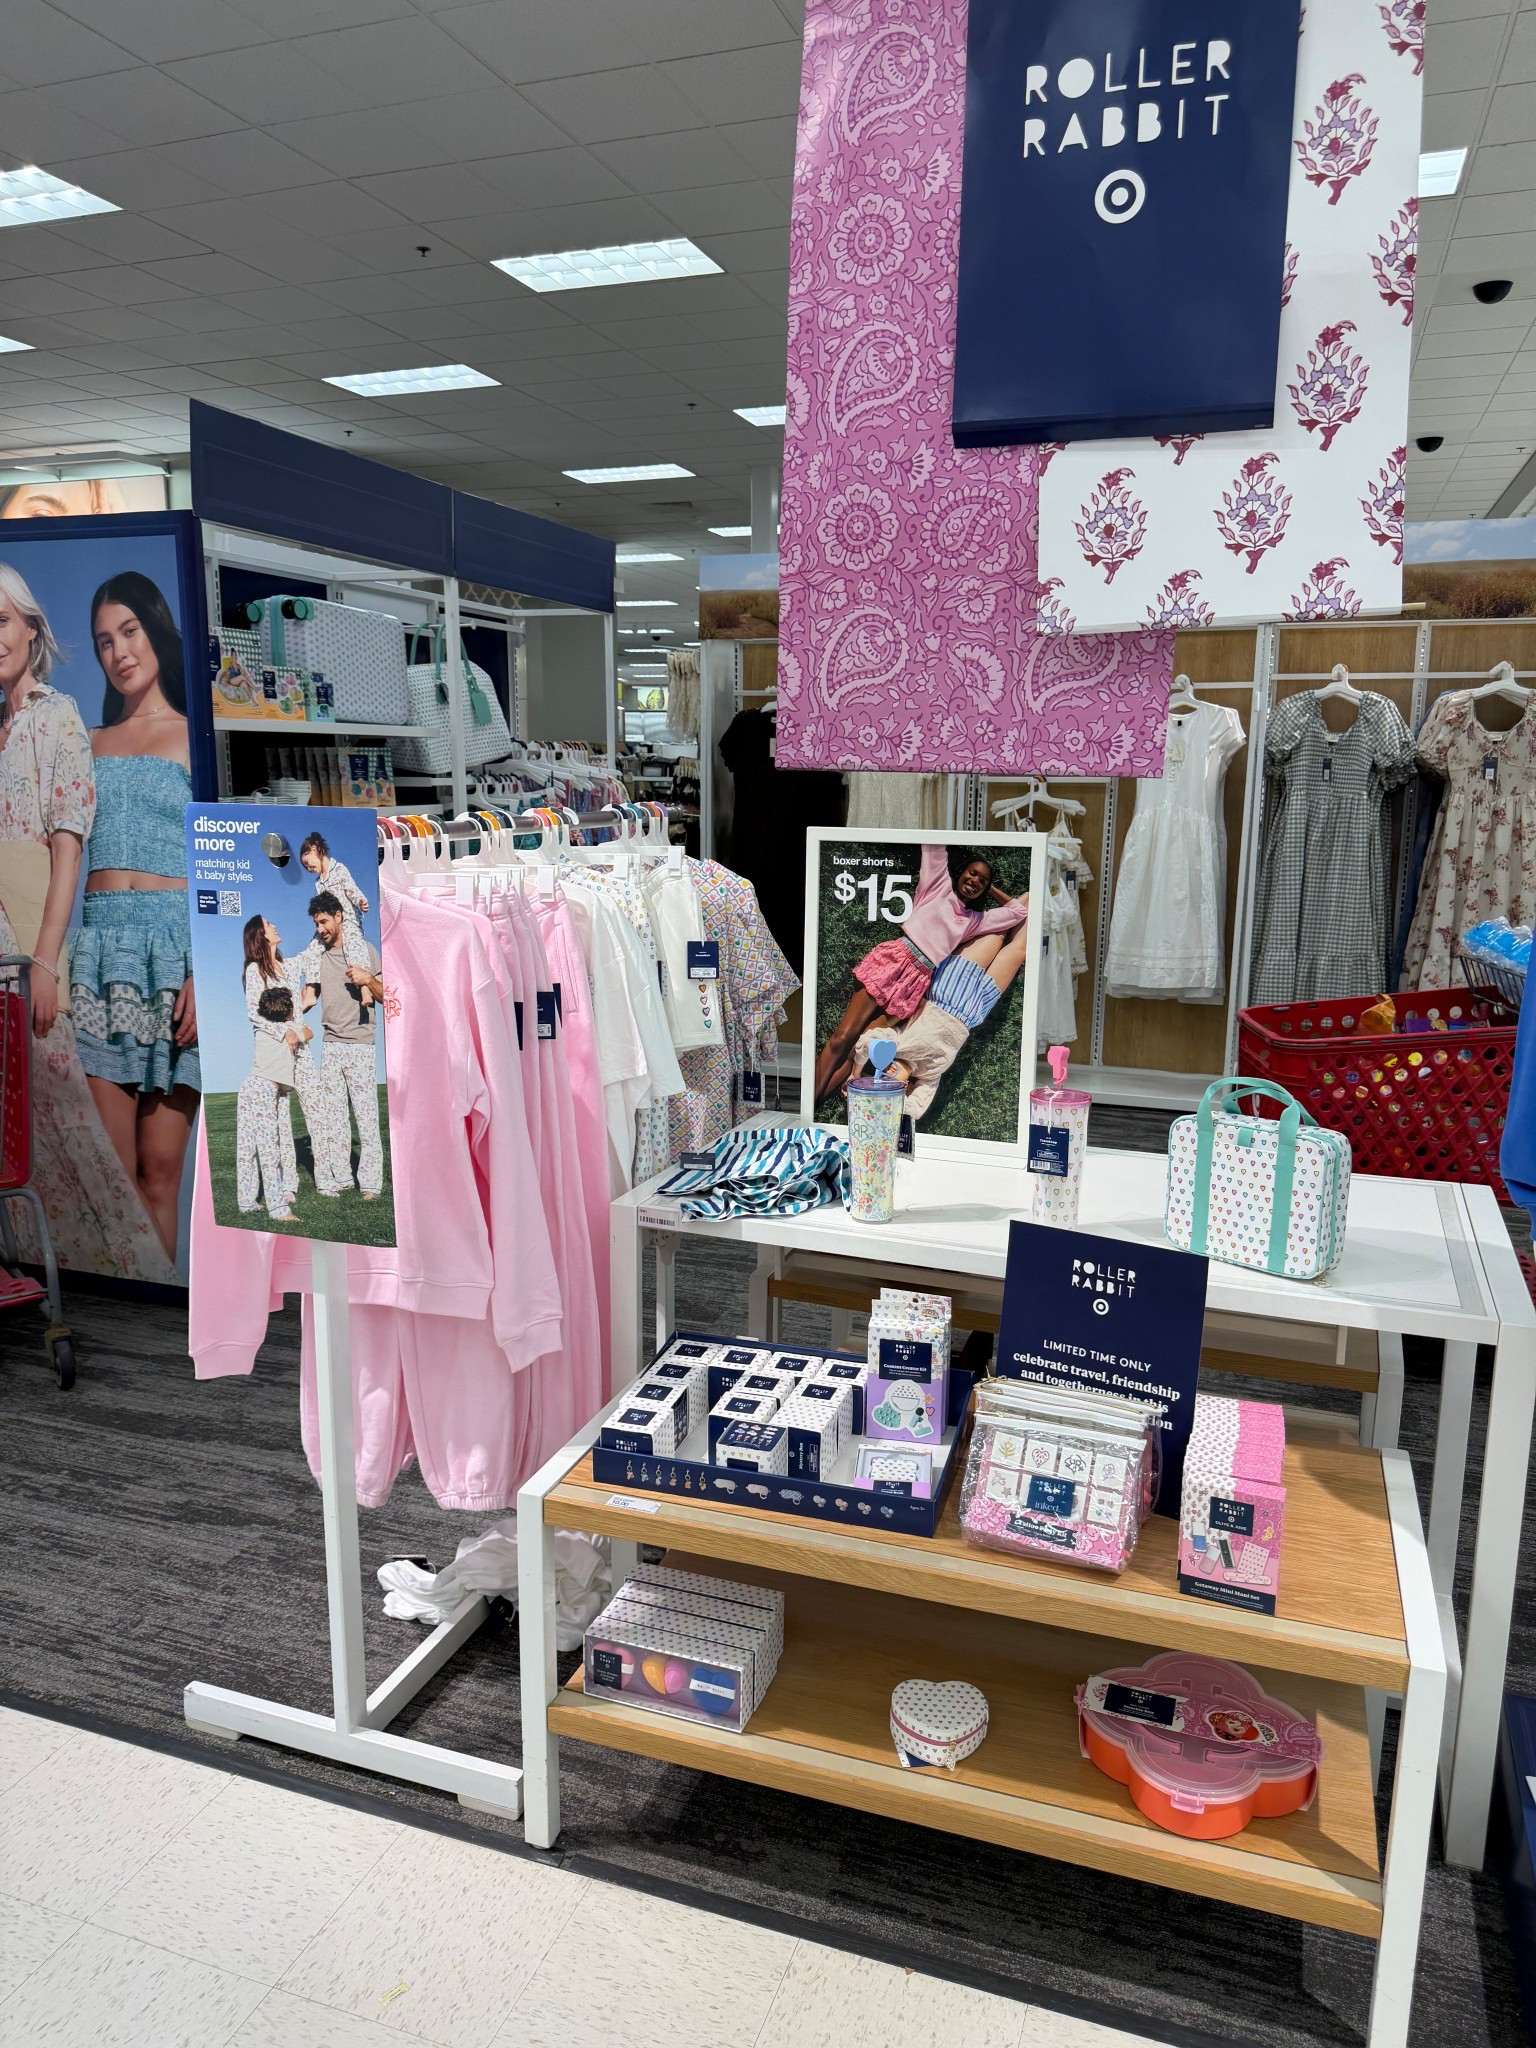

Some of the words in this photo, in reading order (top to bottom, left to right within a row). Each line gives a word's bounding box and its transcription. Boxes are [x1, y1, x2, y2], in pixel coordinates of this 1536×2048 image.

[1024, 40, 1231, 106] ROLLER
[1022, 95, 1230, 159] RABBIT
[193, 816, 261, 834] discover
[194, 837, 236, 852] more
[195, 858, 235, 871] matching
[236, 859, 251, 870] kid
[833, 856, 861, 867] boxer
[862, 857, 894, 868] shorts
[195, 869, 203, 880] &
[204, 870, 226, 883] baby
[227, 871, 254, 884] styles
[833, 870, 914, 924] $15
[1073, 1259, 1136, 1284] ROLLER
[1071, 1274, 1136, 1298] RABBIT
[1043, 1339, 1087, 1358] LIMITED
[1089, 1349, 1117, 1365] TIME
[1119, 1357, 1152, 1373] ONLY
[1013, 1352, 1069, 1373] celebrate
[1070, 1364, 1110, 1385] travel,
[1111, 1373, 1181, 1402] friendship
[1020, 1369, 1045, 1382] and
[615, 1439, 638, 1448] ROLLER
[615, 1444, 638, 1453] RABBIT
[1219, 1502, 1245, 1512] ROLLER
[1219, 1507, 1245, 1517] RABBIT
[1194, 1581, 1220, 1592] Getaway
[1220, 1587, 1234, 1595] Mini
[1234, 1590, 1250, 1599] Mani
